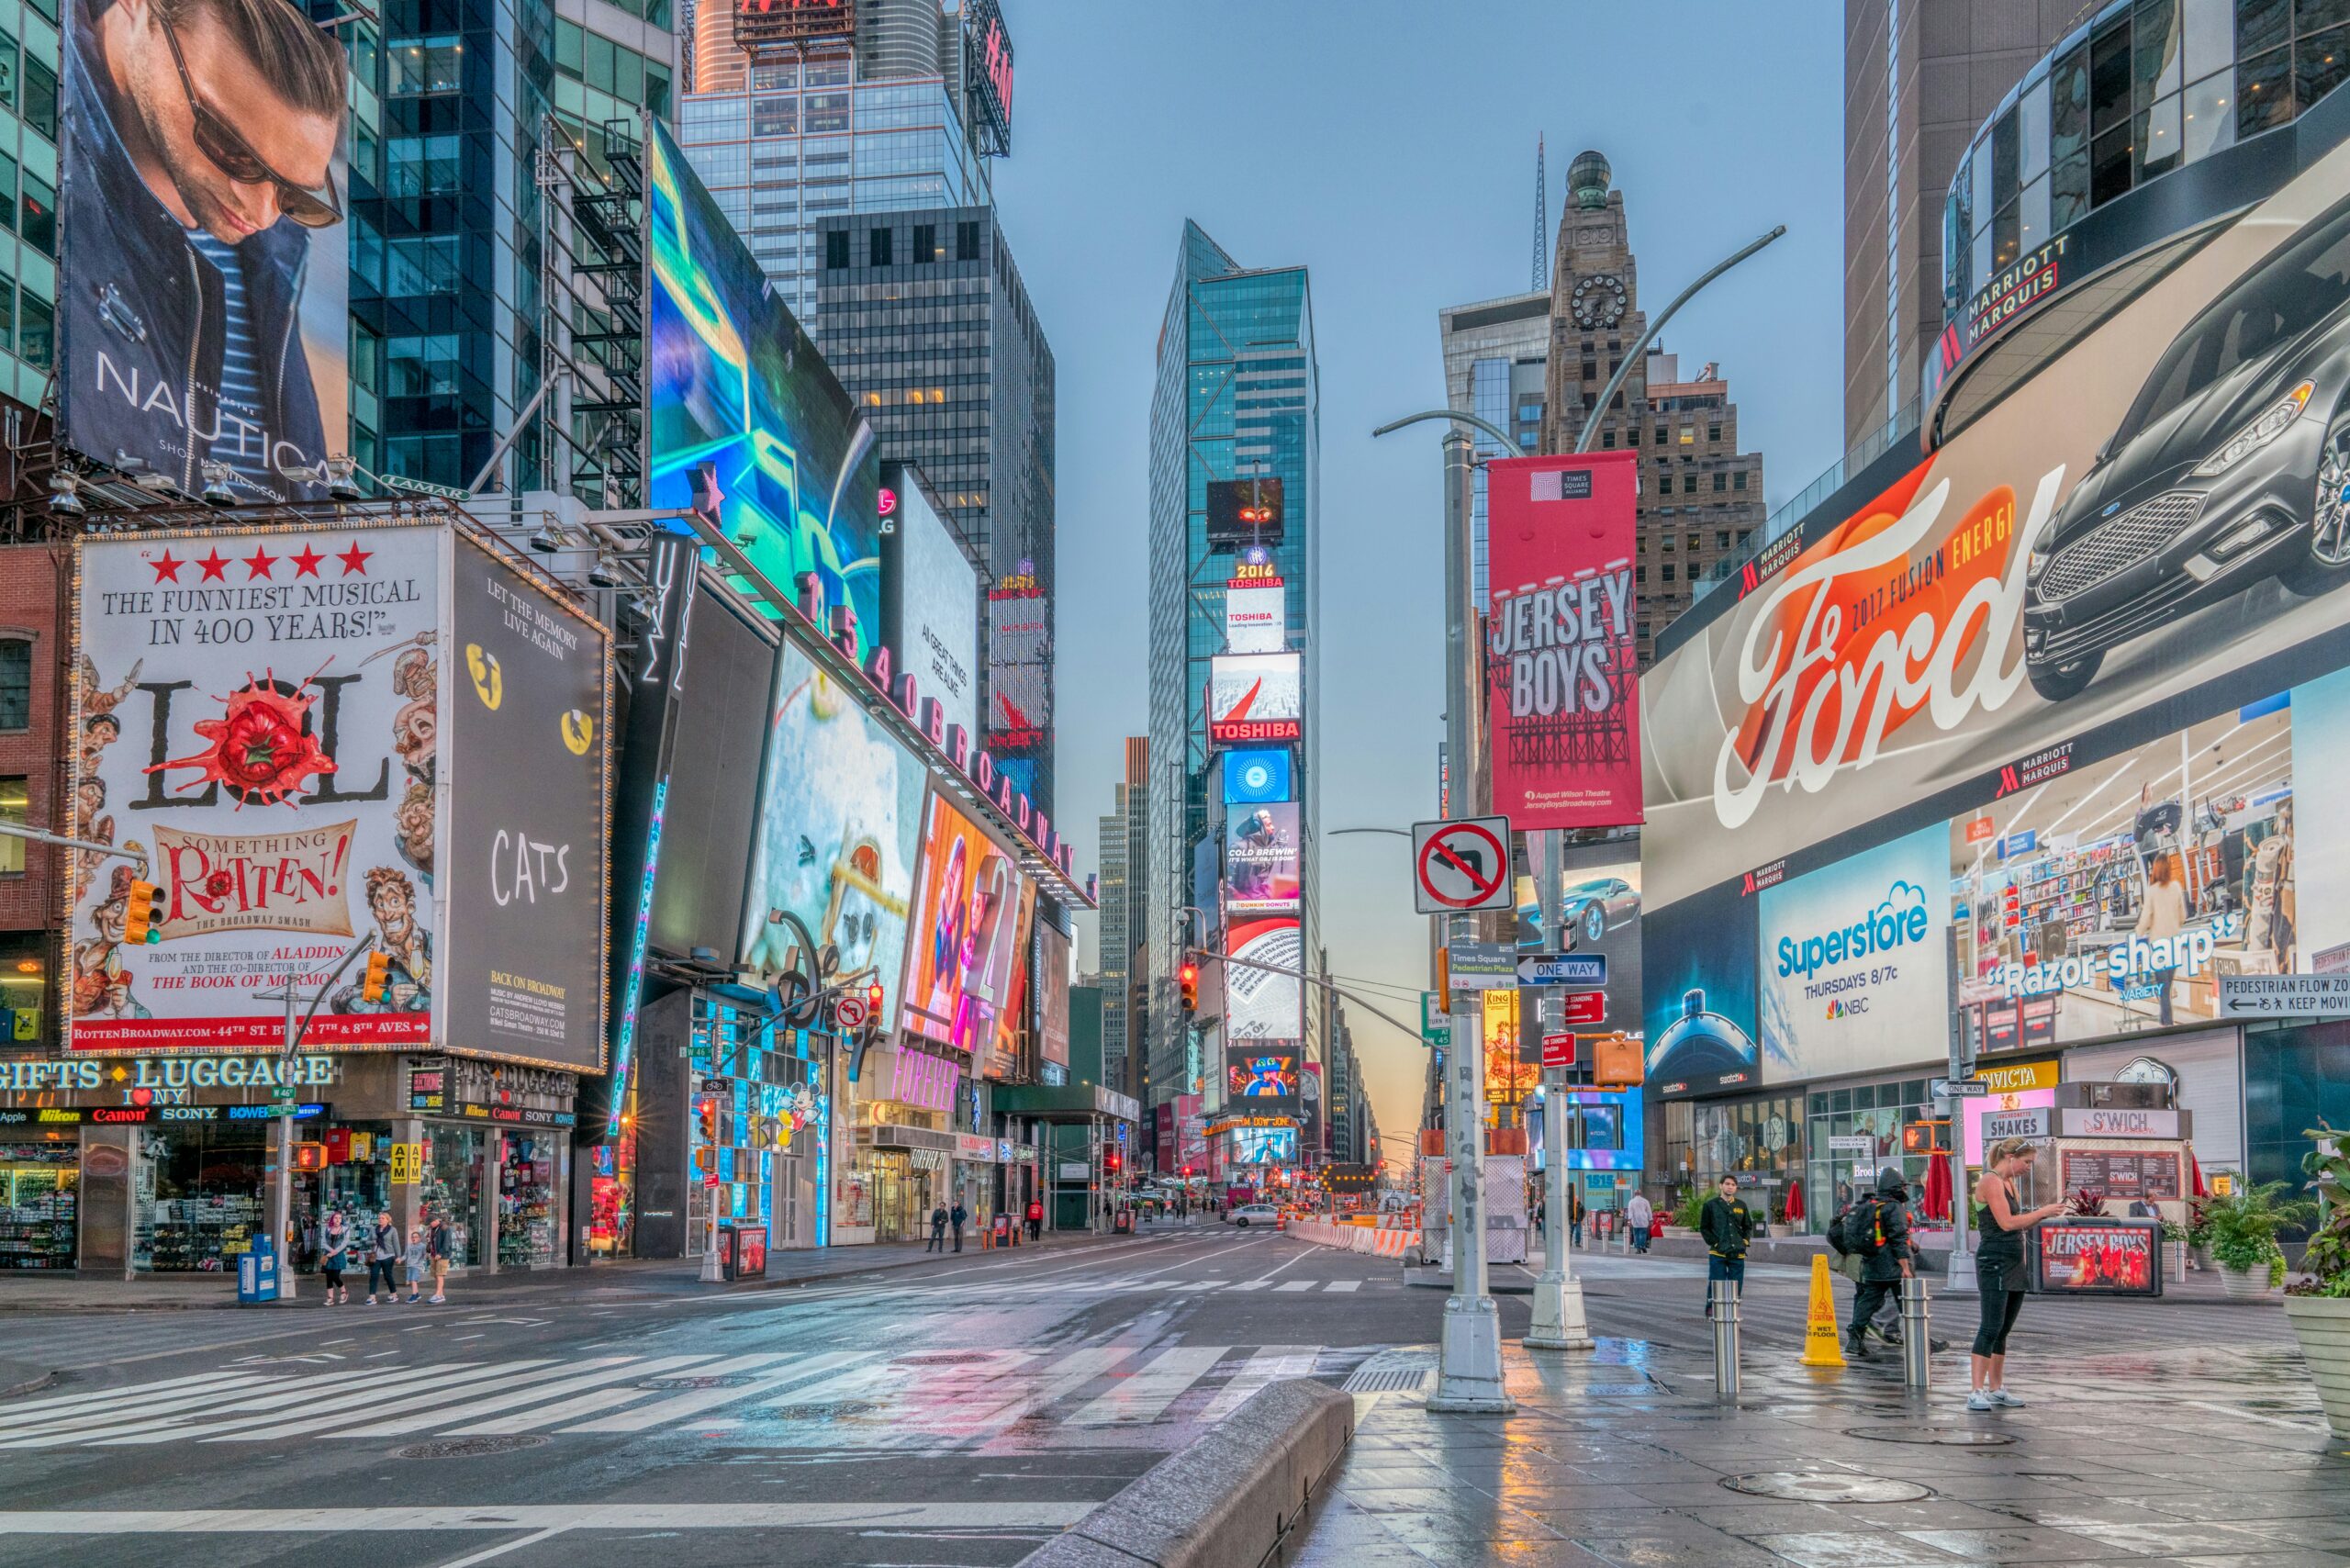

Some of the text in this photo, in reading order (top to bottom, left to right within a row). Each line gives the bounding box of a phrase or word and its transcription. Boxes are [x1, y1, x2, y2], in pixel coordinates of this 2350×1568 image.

[1967, 235, 2069, 321] MARRIOTT
[1968, 267, 2054, 346] MARQUIS
[196, 381, 255, 416] REIMAGINE
[97, 351, 334, 488] NAUTICA
[388, 477, 463, 498] LAMAR
[1761, 521, 1806, 565] MARRIOTT
[1237, 564, 1274, 578] 2016
[1761, 542, 1800, 579] MARQUIS
[1852, 502, 2012, 633] 2017 FUSION ENERGI
[1228, 577, 1282, 588] TOSHIBA
[102, 579, 420, 615] THE FUNNIEST MUSICAL
[487, 577, 577, 651] LET THE MEMORY
[1229, 612, 1272, 622] TOSHIBA
[1493, 567, 1633, 655] JERSEY
[148, 618, 185, 645] IN
[194, 617, 254, 644] 400
[504, 609, 564, 661] LIVE AGAIN
[1713, 463, 2067, 830] Ford
[930, 633, 968, 689] GREAT THINGS
[932, 656, 959, 700] ARE ALIKE
[1512, 642, 1612, 717] BOYS
[793, 571, 1074, 878] 1540 BROADWAY
[1213, 722, 1300, 740] TOSHIBA
[2022, 743, 2074, 771] MARRIOTT
[2022, 758, 2067, 784] MARQUIS
[1525, 800, 1612, 809] JerseyBoysBroadway.com
[1536, 790, 1560, 800] August
[182, 833, 327, 855] SOMETHING
[490, 829, 568, 907] CATS
[1756, 860, 1785, 878] MARRIOTT
[1756, 871, 1782, 888] MARQUIS
[196, 915, 312, 931] THE BROADWAY SMASH
[1778, 900, 1928, 980] Superstore
[149, 946, 346, 963] FROM THE DIRECTOR OF ALADDIN
[1477, 955, 1506, 964] Square
[183, 962, 311, 974] AND THE CO-DIRECTOR OF
[1537, 964, 1595, 976] ONE WAY
[152, 976, 185, 990] THE
[191, 976, 236, 989] BOOK
[241, 975, 263, 988] OF
[491, 969, 566, 1000] BACK ON BROADWAY
[1805, 966, 1897, 1000] THURSDAYS 8/7c
[2226, 980, 2330, 993] PEDESTRIAN FLOW
[490, 987, 507, 999] MUSIC
[506, 991, 514, 1000] BY
[513, 992, 532, 1004] ANDREW
[533, 998, 548, 1008] LLOYD
[548, 1001, 565, 1013] WEBBER
[1487, 992, 1509, 1006] KING
[1570, 995, 1594, 1003] STANDING
[1844, 997, 1871, 1017] NBC
[2288, 996, 2350, 1010] KEEP MOVI
[489, 1005, 565, 1031] CATSBROADWAY.COM
[504, 1019, 518, 1030] Simon
[518, 1022, 533, 1033] Theatre
[550, 1029, 559, 1038] 52nd
[341, 1024, 350, 1035] &
[135, 1056, 334, 1088] LUGGAGE
[891, 1045, 959, 1113] FOREVER
[1720, 1073, 1740, 1084] swatch
[1979, 1067, 2036, 1088] INVICTA
[151, 1089, 187, 1104] NY
[274, 1089, 279, 1097] W
[1662, 1083, 1680, 1093] swatch
[1966, 1084, 1983, 1092] WAY
[0, 1107, 218, 1123] Apple Nikon Canon SONY
[465, 1104, 575, 1125] Nikon Canon SONY BOWER
[1254, 1117, 1269, 1126] DOW
[1991, 1118, 2037, 1137] SHAKES
[394, 1146, 405, 1178] ATM
[910, 1148, 946, 1171] FOREVER 21
[1586, 1175, 1614, 1188] 1515
[2047, 1234, 2148, 1255] JERSEY BOYS
[1814, 1314, 1834, 1322] CAUTION
